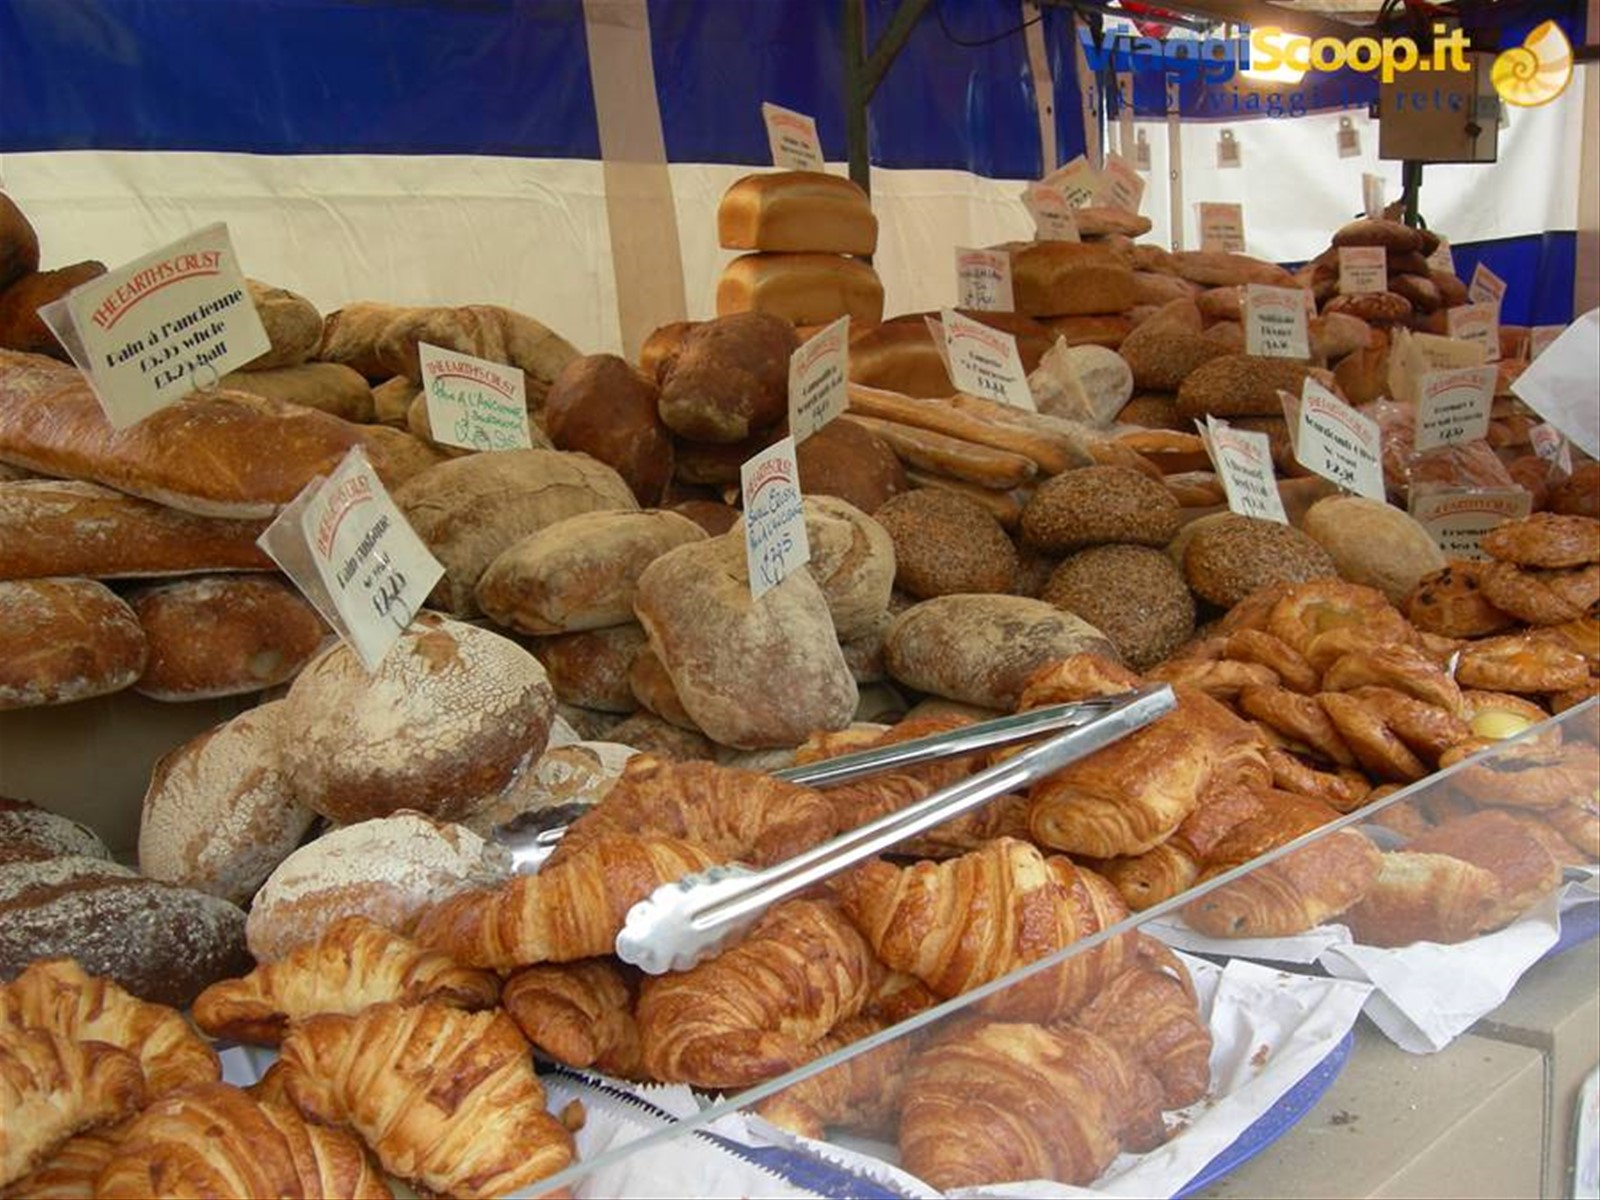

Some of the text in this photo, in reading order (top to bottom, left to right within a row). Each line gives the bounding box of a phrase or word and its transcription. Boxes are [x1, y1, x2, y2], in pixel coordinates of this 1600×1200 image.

[92, 299, 118, 329] THE
[174, 252, 221, 274] CRUST
[183, 321, 226, 350] whole
[106, 338, 144, 369] Pain
